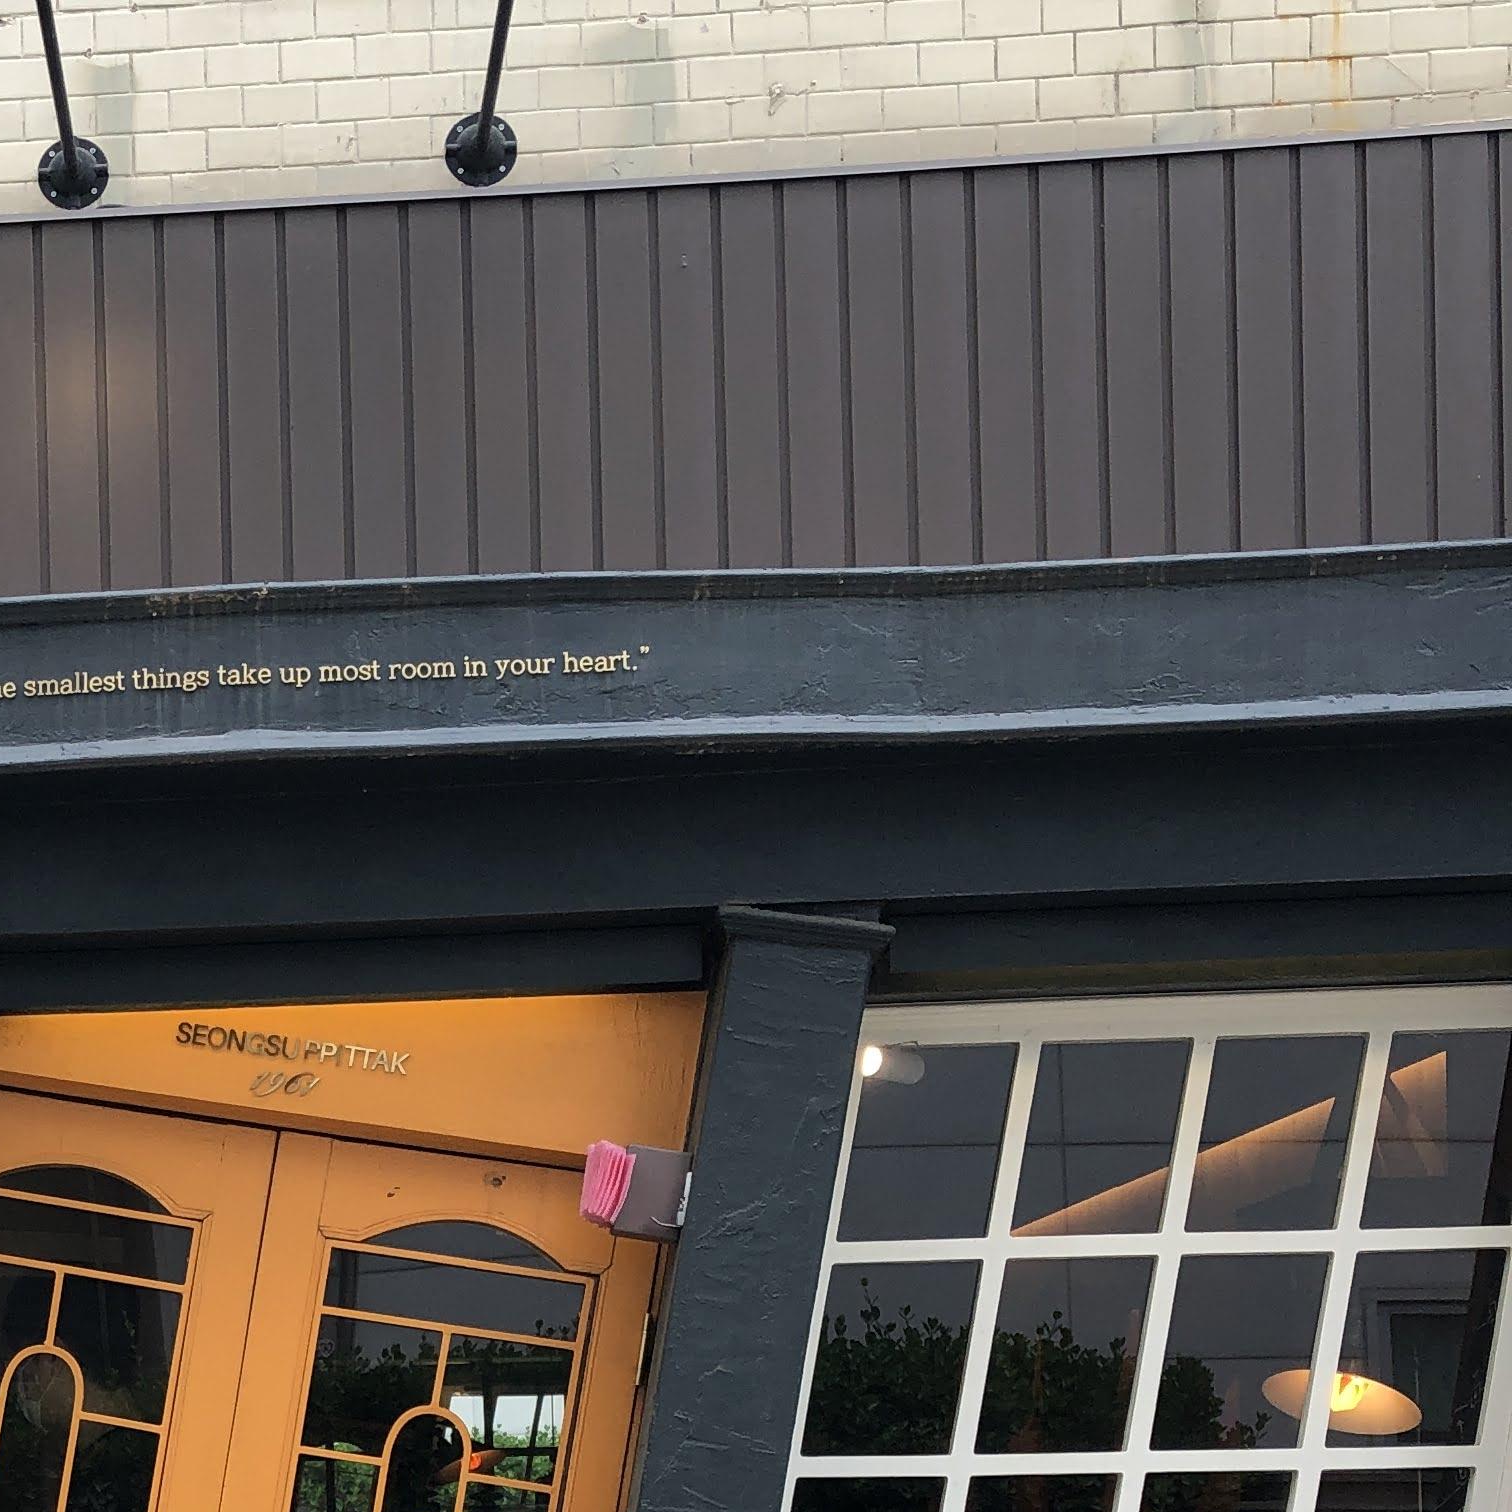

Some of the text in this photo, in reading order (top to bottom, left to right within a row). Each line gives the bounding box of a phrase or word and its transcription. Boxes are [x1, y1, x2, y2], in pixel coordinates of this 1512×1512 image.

[23, 671, 126, 698] smallest
[132, 667, 210, 692] things
[217, 663, 272, 686] take
[279, 665, 311, 688] up
[319, 660, 381, 683] most
[388, 660, 457, 681] room
[463, 655, 488, 678] in
[495, 656, 556, 681] your
[175, 1021, 410, 1076] SEONGSU PPITTAK
